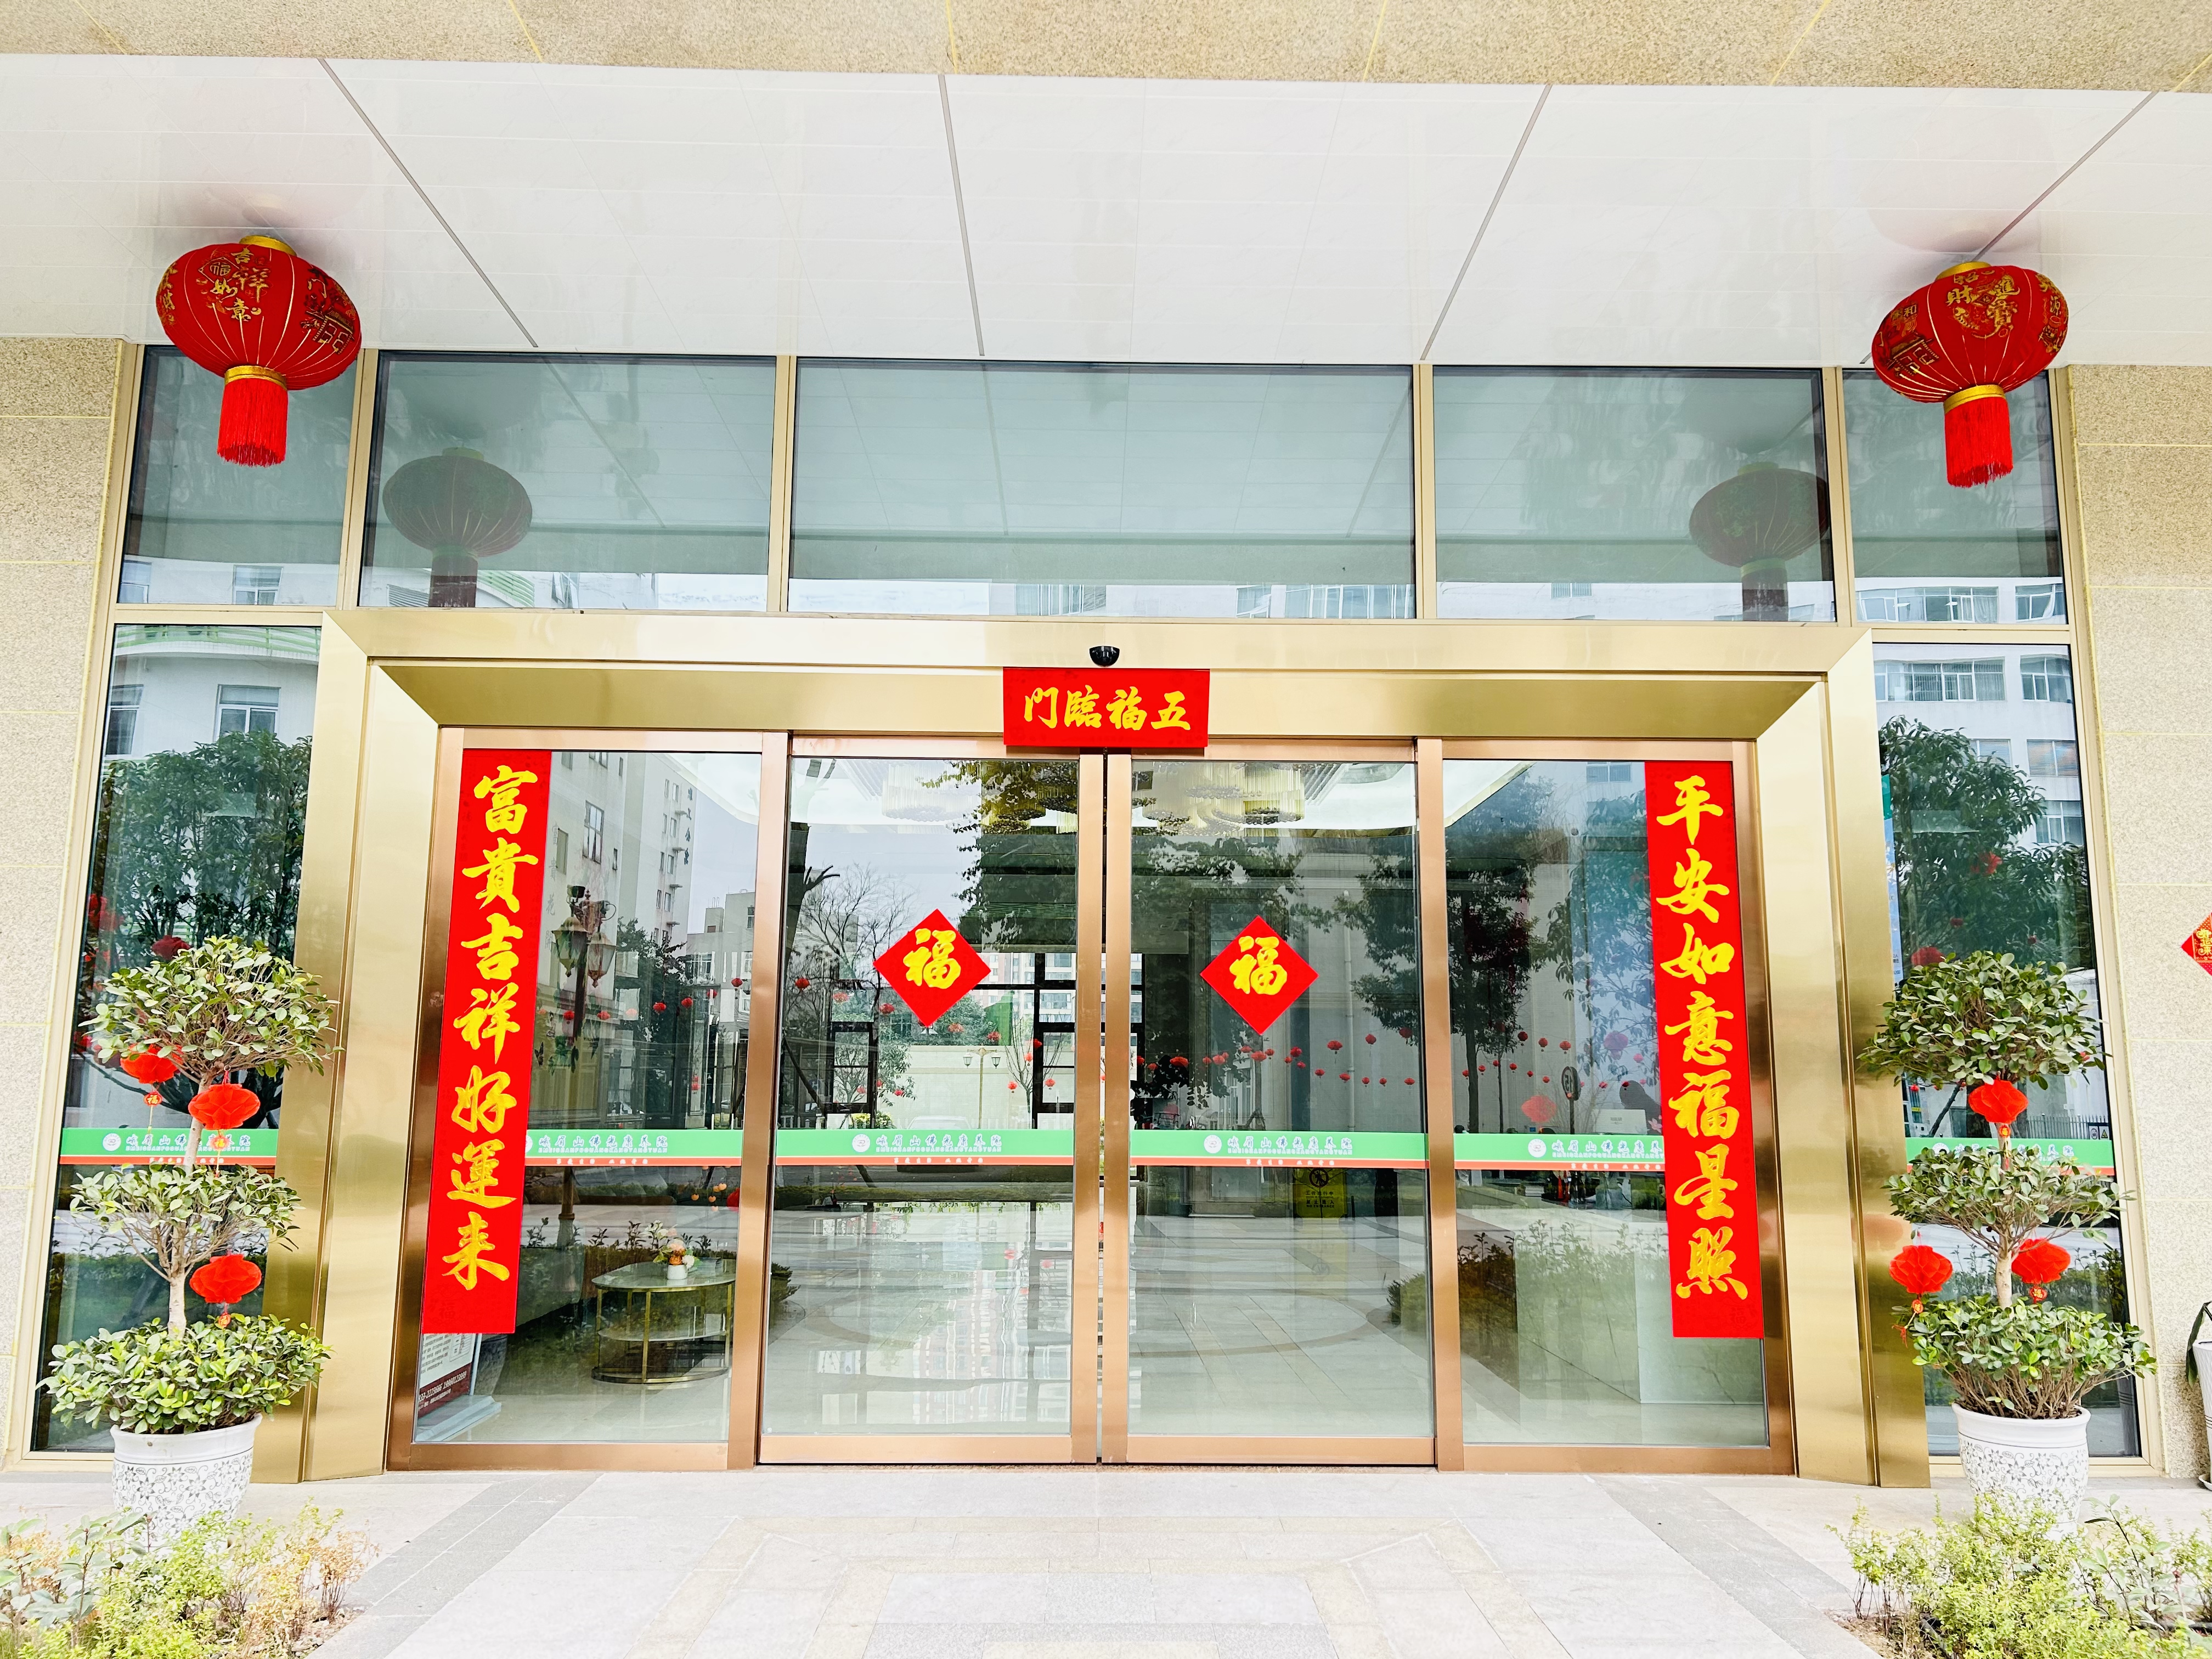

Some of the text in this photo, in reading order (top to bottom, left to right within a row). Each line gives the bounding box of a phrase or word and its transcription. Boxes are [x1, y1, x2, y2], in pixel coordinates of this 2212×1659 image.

[903, 928, 961, 989] 福
[1229, 935, 1288, 995] 福
[1656, 775, 1748, 1300] 平安如意福星照
[147, 1094, 159, 1104] 福
[214, 1138, 225, 1147] 福
